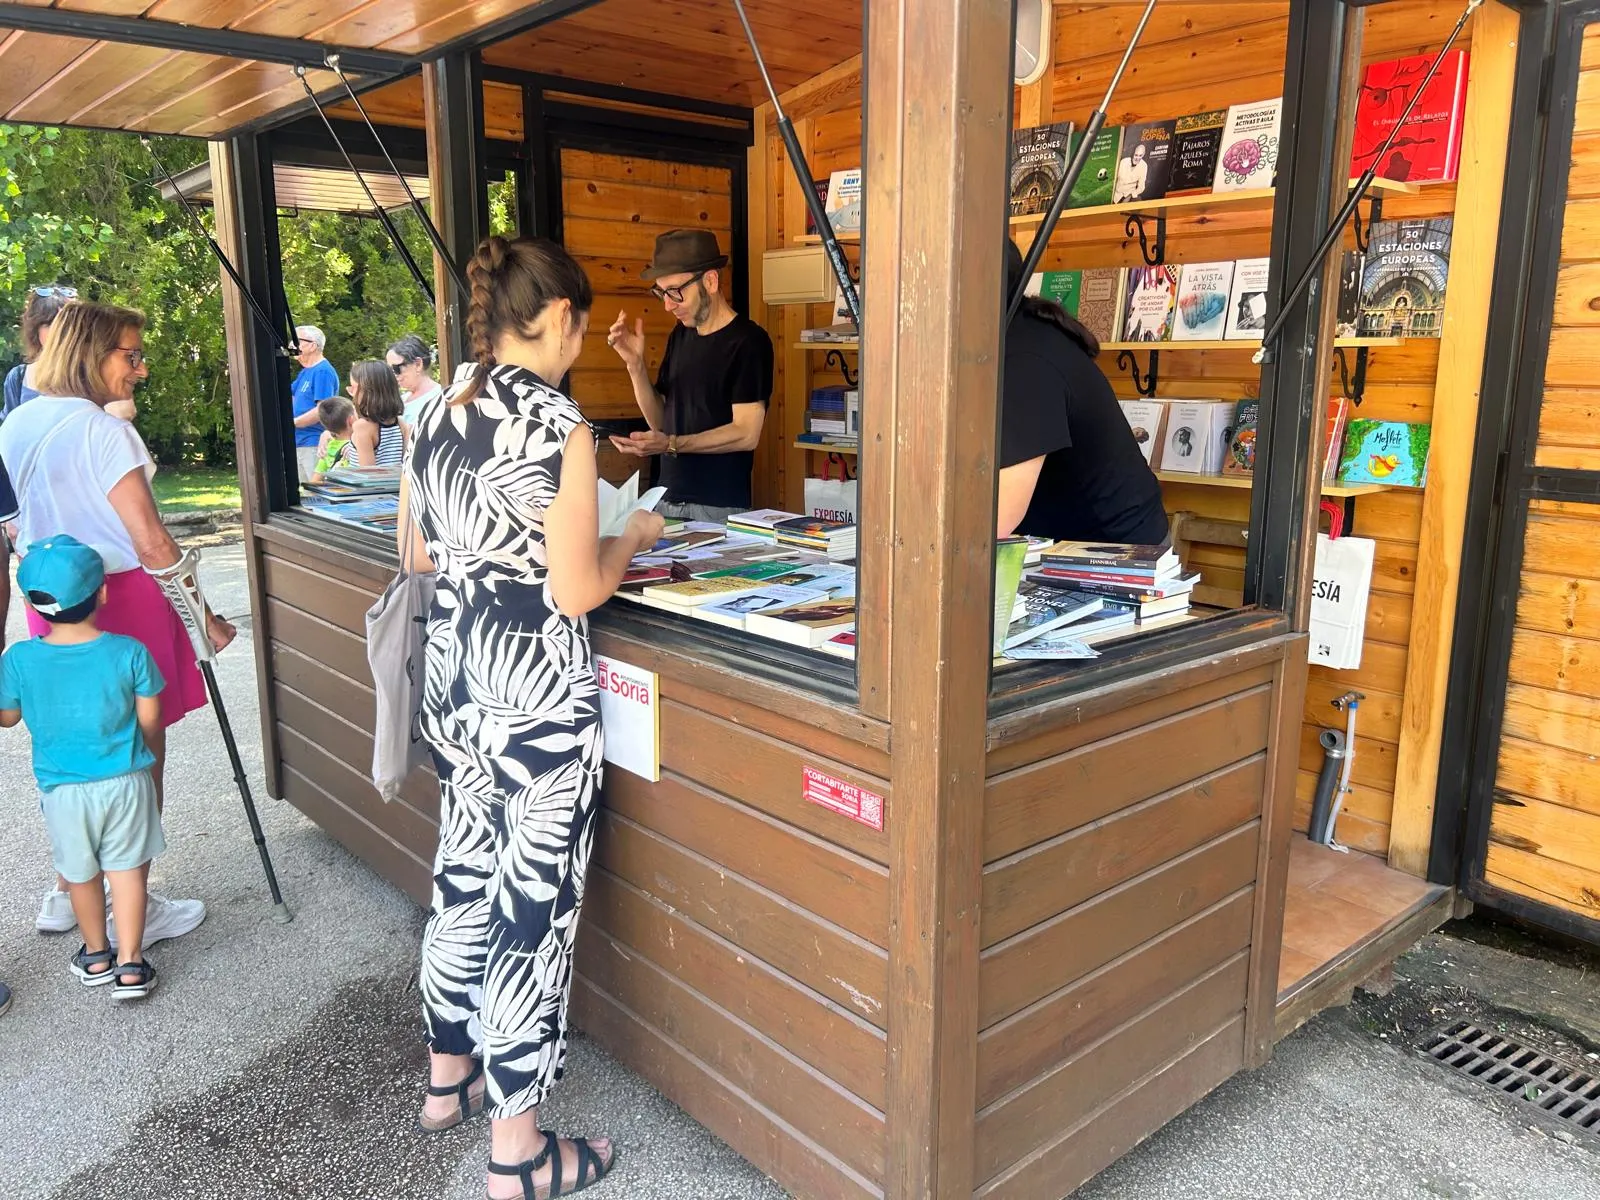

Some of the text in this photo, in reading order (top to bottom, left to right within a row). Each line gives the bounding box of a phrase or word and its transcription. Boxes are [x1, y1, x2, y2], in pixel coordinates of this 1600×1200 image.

[1037, 133, 1046, 141] 50
[1019, 140, 1061, 154] ESTACIONES
[1021, 151, 1056, 164] EUROPEAS
[1179, 150, 1203, 160] AZULES
[1182, 159, 1203, 169] ROMA
[1406, 230, 1419, 239] 50
[1378, 241, 1442, 253] ESTACIONES
[1381, 254, 1436, 265] EUROPEAS
[1188, 273, 1223, 283] LA VISTA
[1191, 281, 1217, 291] ATRÁS
[814, 508, 853, 524] EXPOESÍA
[1311, 579, 1342, 603] ESÍA
[610, 671, 650, 705] Soria
[807, 769, 859, 798] CORTABITARTE
